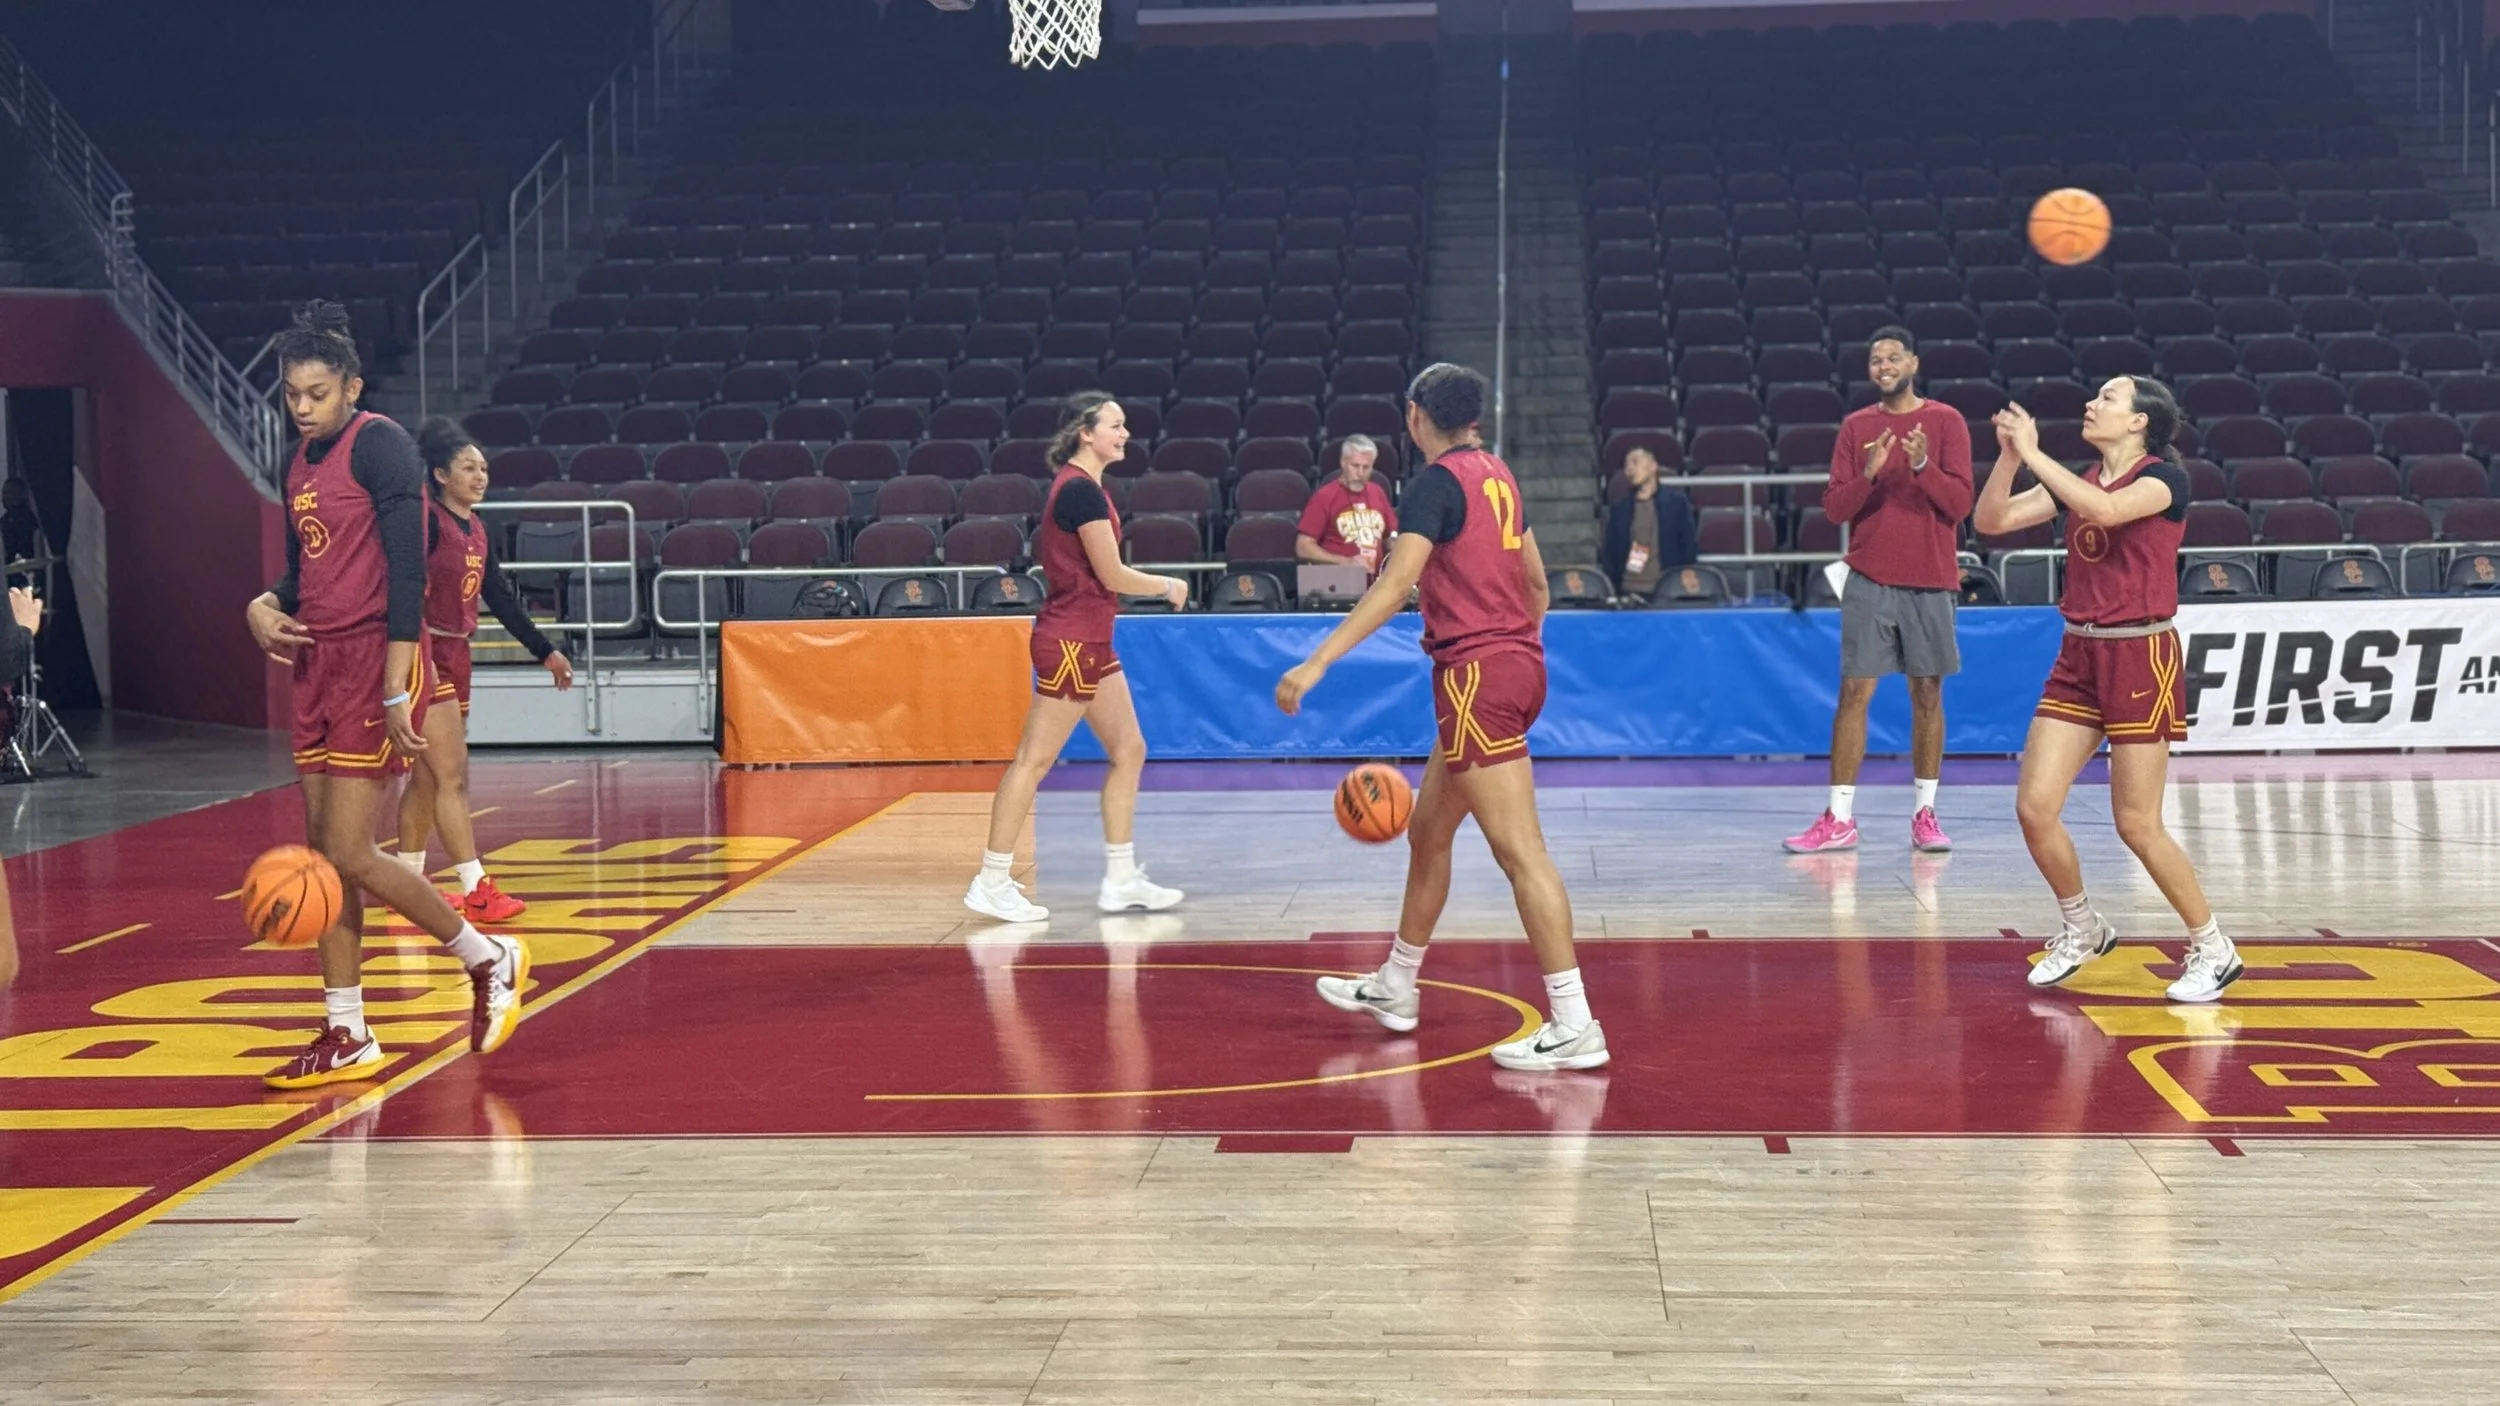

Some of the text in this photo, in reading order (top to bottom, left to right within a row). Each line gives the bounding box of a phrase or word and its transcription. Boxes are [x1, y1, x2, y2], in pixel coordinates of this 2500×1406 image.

[294, 492, 317, 511] USC
[1482, 477, 1522, 550] 12
[465, 554, 482, 568] USC
[2185, 627, 2463, 727] FIRST
